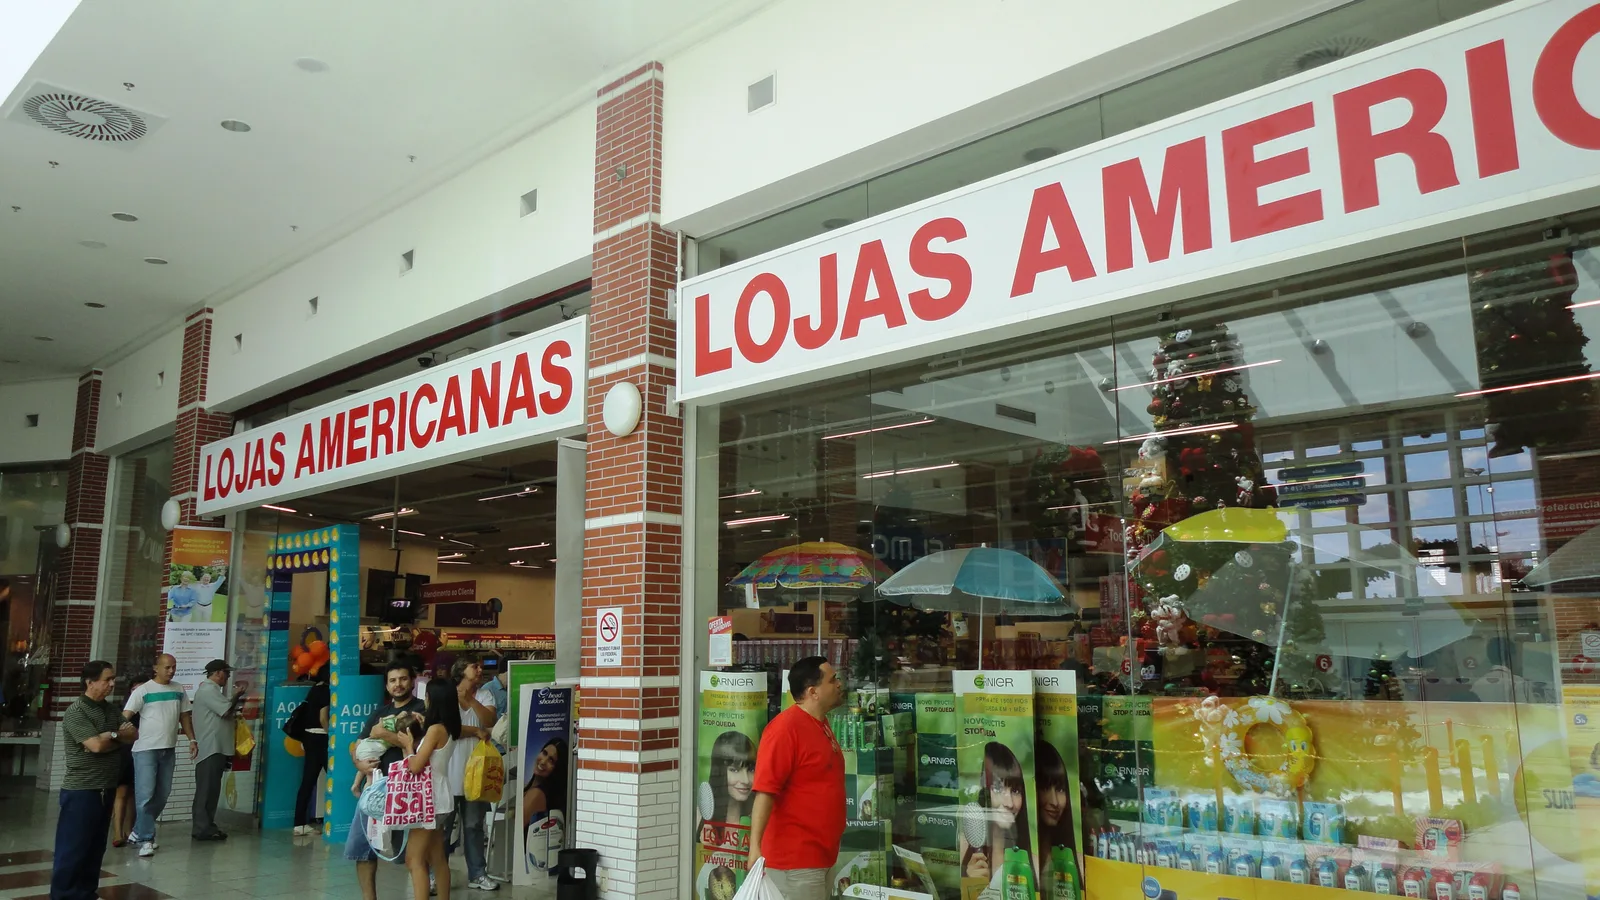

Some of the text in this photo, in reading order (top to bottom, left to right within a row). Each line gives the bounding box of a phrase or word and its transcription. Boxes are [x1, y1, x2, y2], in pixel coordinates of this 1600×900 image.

[695, 217, 973, 377] LOJAS
[203, 340, 573, 501] LOJAS AMERICANAS
[423, 586, 475, 599] Atendimento ao Cliente
[461, 617, 496, 627] Coloração
[709, 618, 723, 630] OFERTA
[1124, 661, 1131, 672] 5
[1319, 657, 1328, 669] 6
[1467, 659, 1475, 668] 2
[711, 675, 754, 687] GARNIER
[538, 697, 565, 705] shoulders
[921, 755, 956, 765] GARNIER
[1105, 764, 1150, 776] GARNIER
[918, 814, 955, 827] GARNIER
[703, 827, 739, 847] LOJAS
[853, 885, 886, 899] GARNIER
